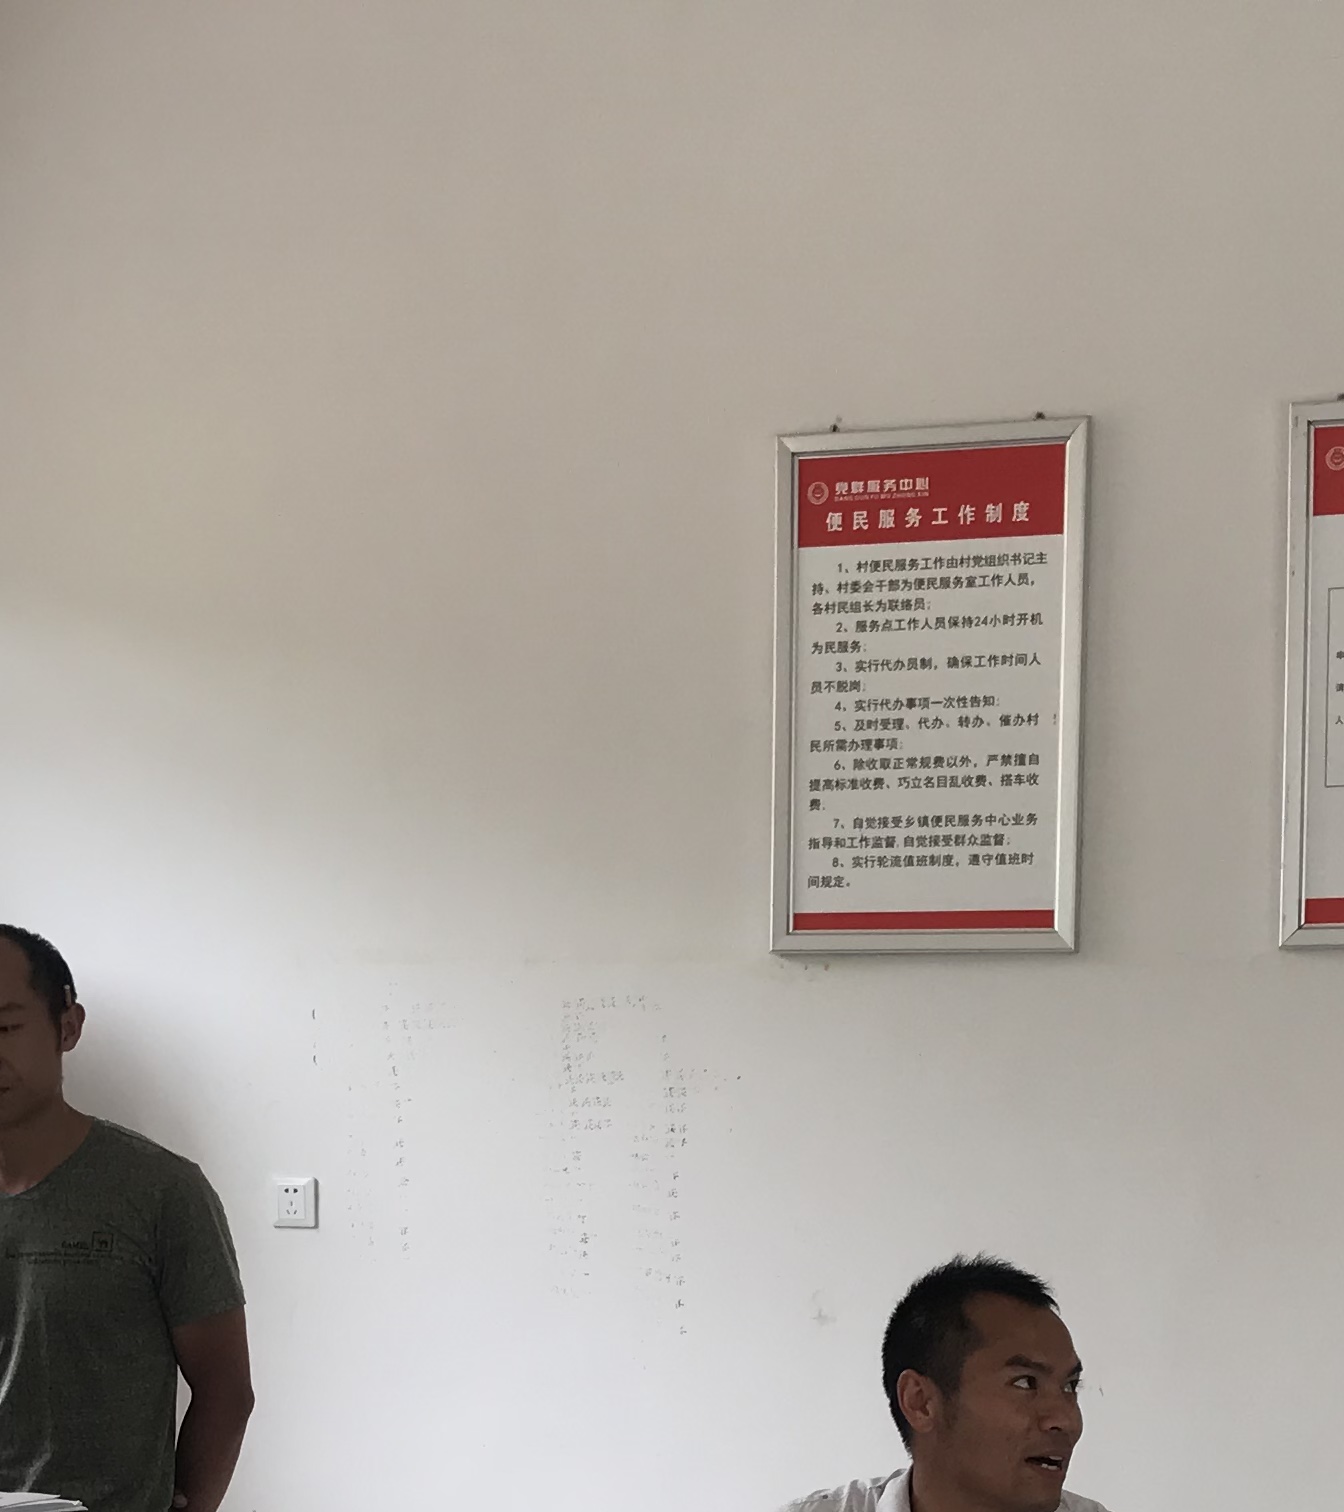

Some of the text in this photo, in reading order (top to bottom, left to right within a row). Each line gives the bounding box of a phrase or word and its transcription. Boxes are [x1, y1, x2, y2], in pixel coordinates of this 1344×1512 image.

[834, 477, 929, 495] 党群服务中心
[826, 501, 1030, 532] 便民服务工作制度
[837, 552, 1048, 574] 1、村便民服务工作由村党组织书记主
[836, 613, 1043, 633] 2、服务点工作人员保持24小时开机
[1335, 650, 1344, 725] 申请人
[833, 812, 1038, 830] 7、自觉接受乡镇便民服务中心业务
[808, 875, 851, 889] 间规定。
